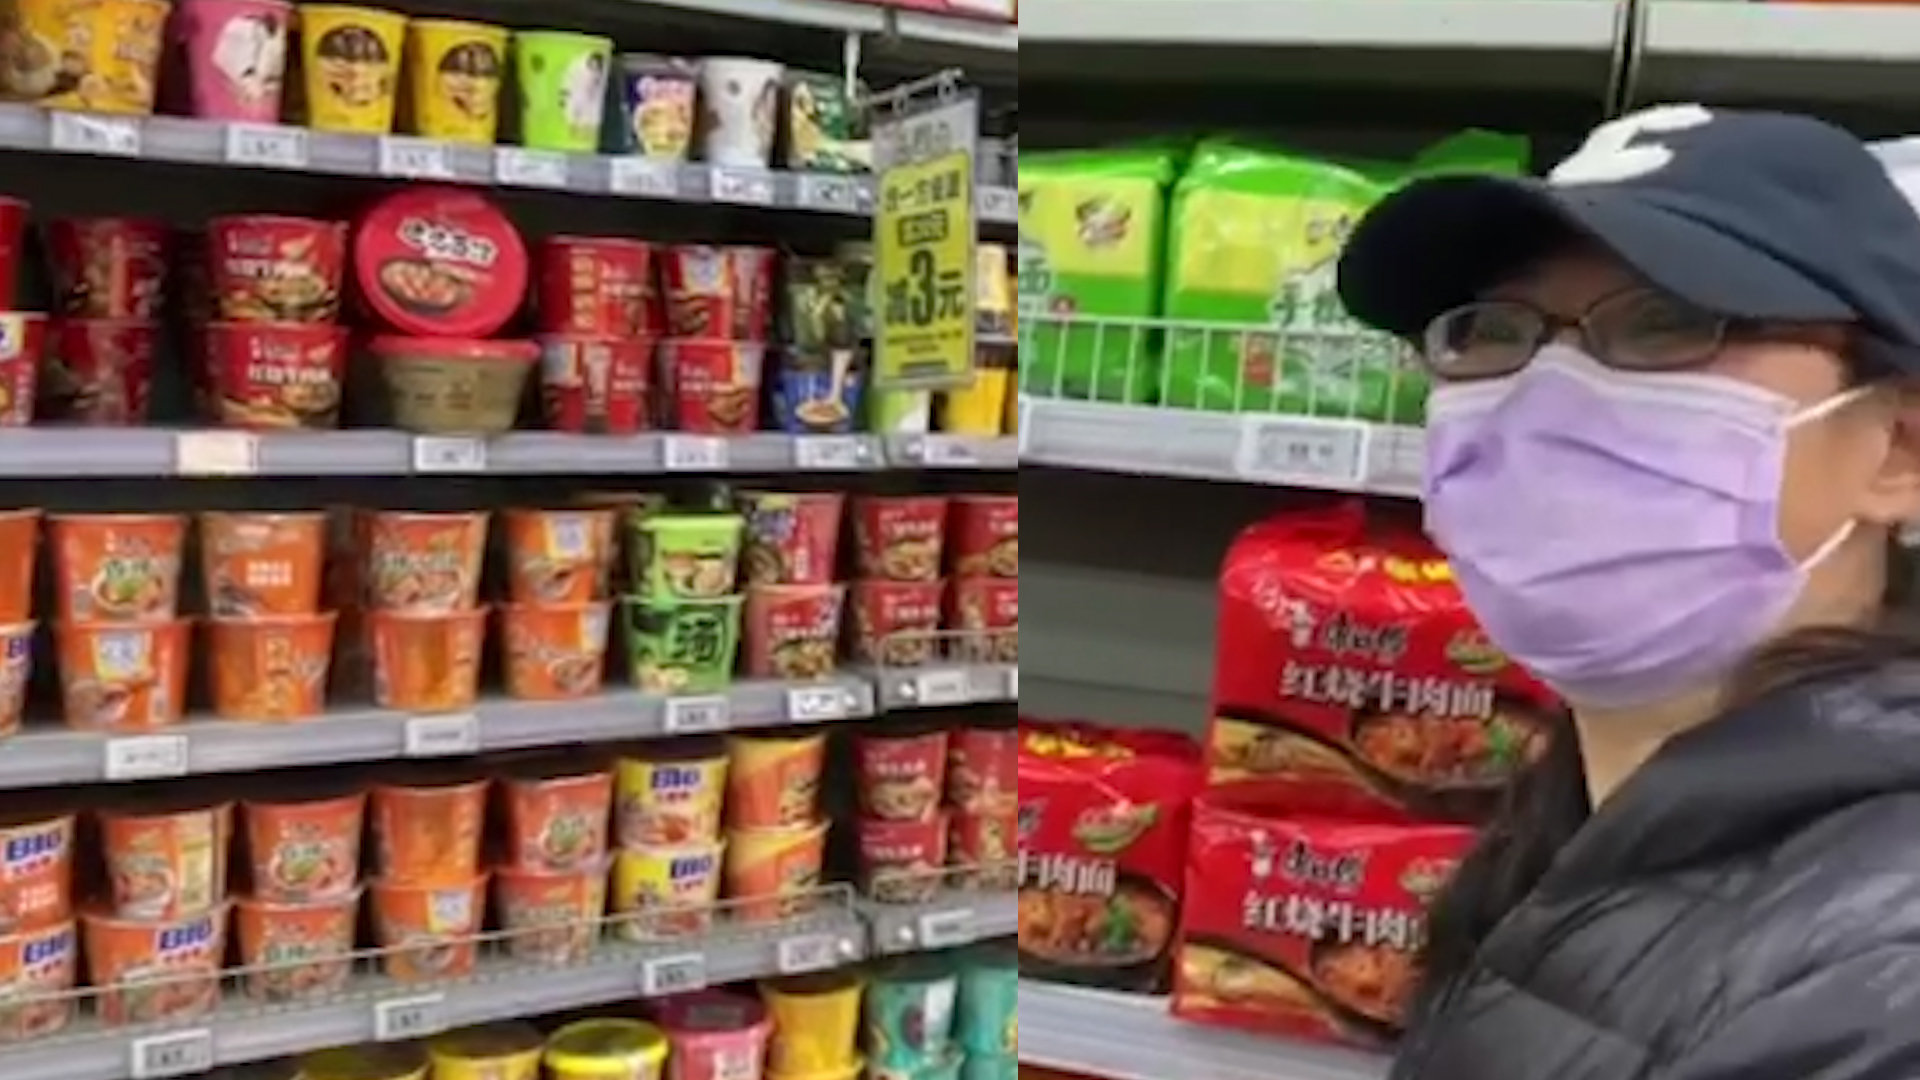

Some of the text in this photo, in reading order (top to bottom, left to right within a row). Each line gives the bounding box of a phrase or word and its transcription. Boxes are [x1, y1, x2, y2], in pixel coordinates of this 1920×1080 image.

[1279, 660, 1495, 719] 红烧牛肉面
